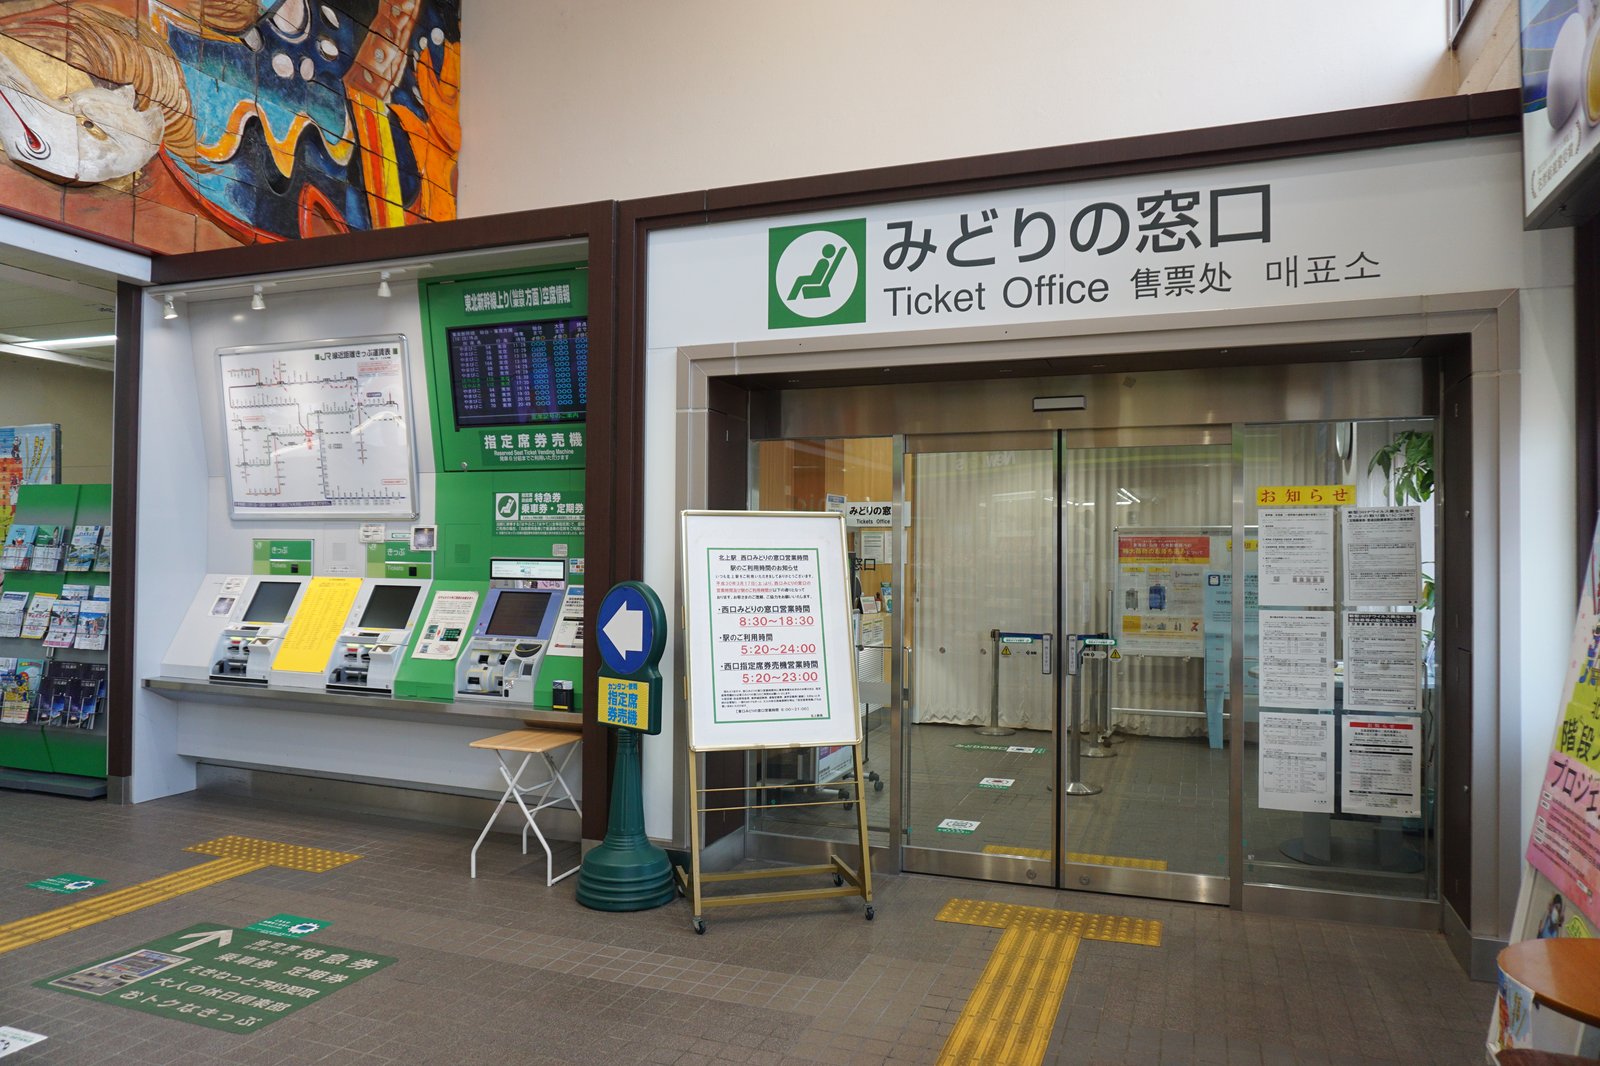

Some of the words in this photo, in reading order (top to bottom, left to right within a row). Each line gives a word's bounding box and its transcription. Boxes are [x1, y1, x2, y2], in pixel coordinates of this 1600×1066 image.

[883, 184, 1271, 272] みどりの窓口
[1266, 250, 1382, 290] 매표소
[1129, 261, 1232, 300] 售票处
[884, 282, 986, 317] Ticket
[1002, 273, 1109, 309] Office
[484, 432, 583, 449] 指定席券売機
[534, 492, 561, 503] 特急券
[1260, 488, 1349, 502] お知らせ
[521, 503, 584, 514] 乗車券・定期券
[271, 546, 288, 554] きっぷ
[387, 548, 405, 556] きっぷ
[739, 615, 814, 627] 8:30～18:30
[741, 643, 816, 655] 5:20～24:00
[742, 672, 818, 684] 5:20～23:00
[607, 691, 639, 709] 指定席
[607, 706, 638, 726] 券売機
[213, 952, 278, 969] 乗車券
[282, 965, 348, 985] 定期券
[296, 948, 379, 970] 特急券
[183, 965, 320, 999] えきねっと予約受取
[151, 977, 292, 1013] 大人の休日倶楽部
[119, 990, 263, 1028] おトクなきっぷ
